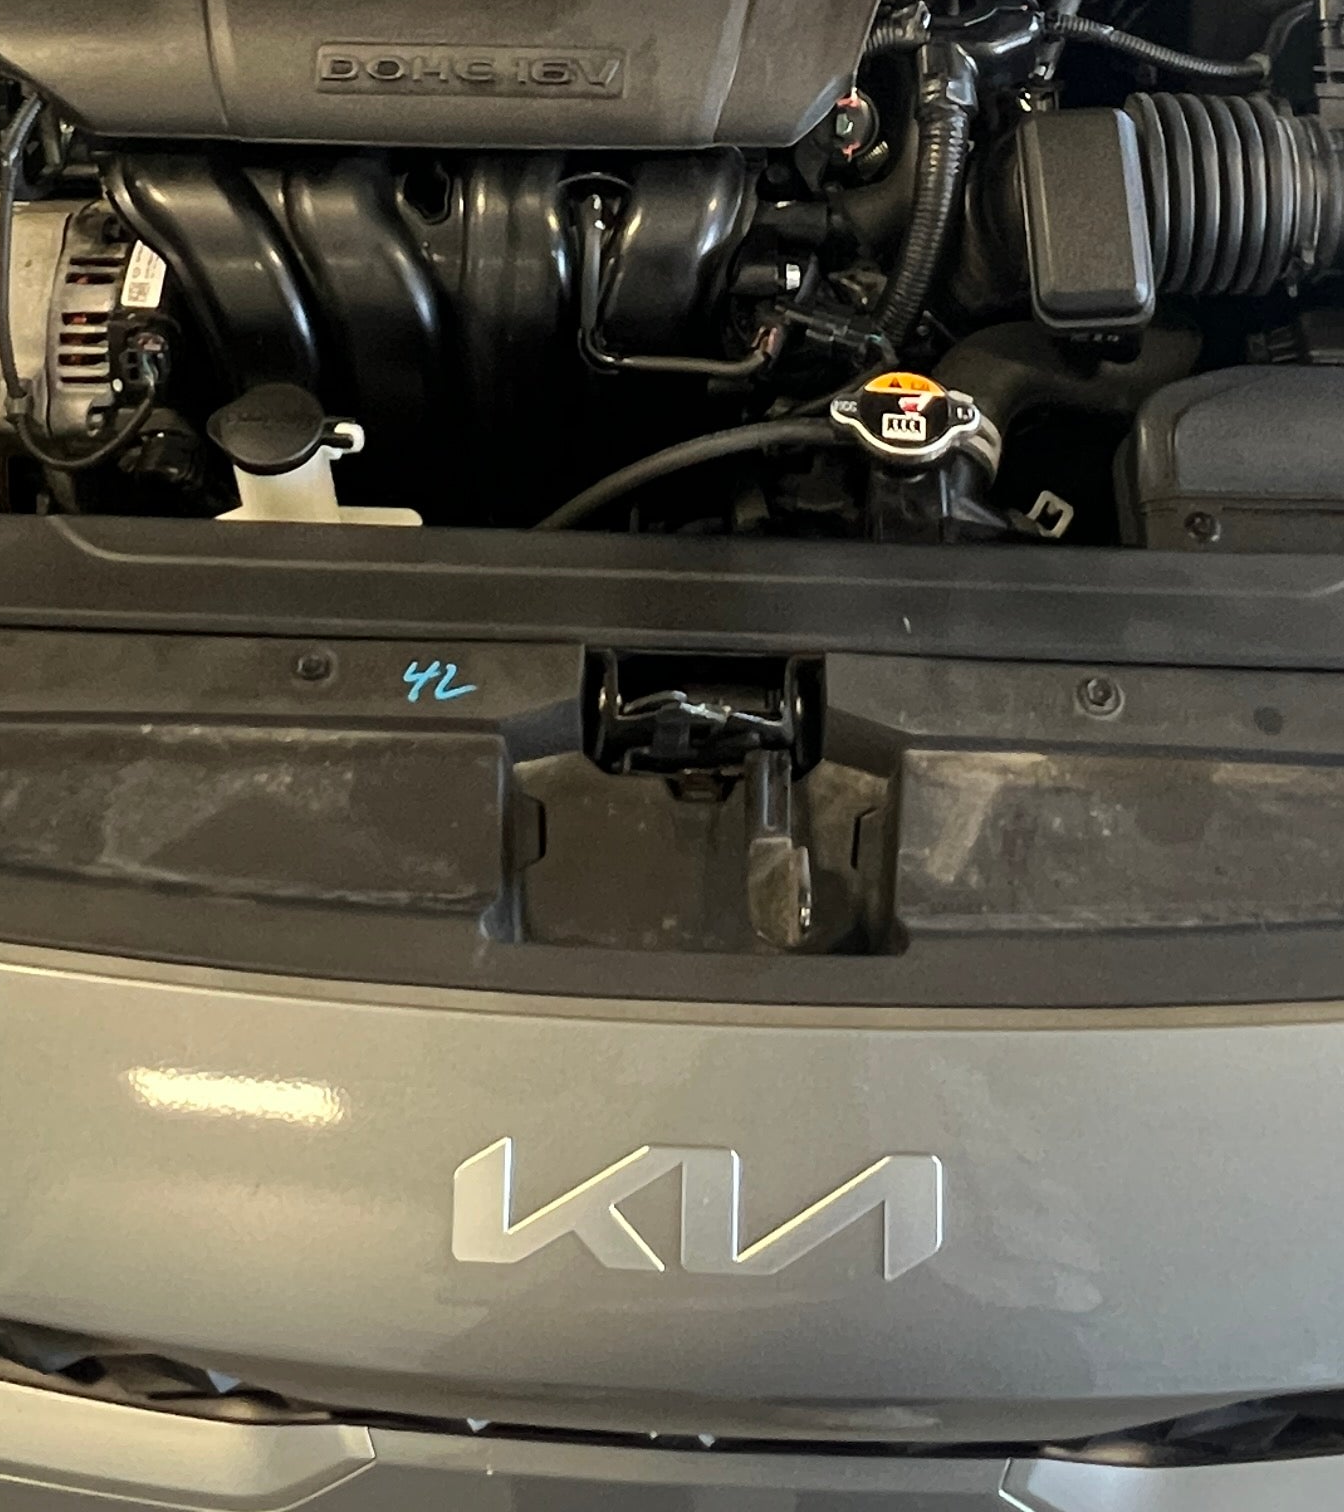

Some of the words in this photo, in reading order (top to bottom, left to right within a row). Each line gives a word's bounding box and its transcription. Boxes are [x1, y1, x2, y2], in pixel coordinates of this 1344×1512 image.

[321, 55, 497, 83] DOHC
[403, 661, 477, 702] 42
[453, 1136, 943, 1281] KIA
